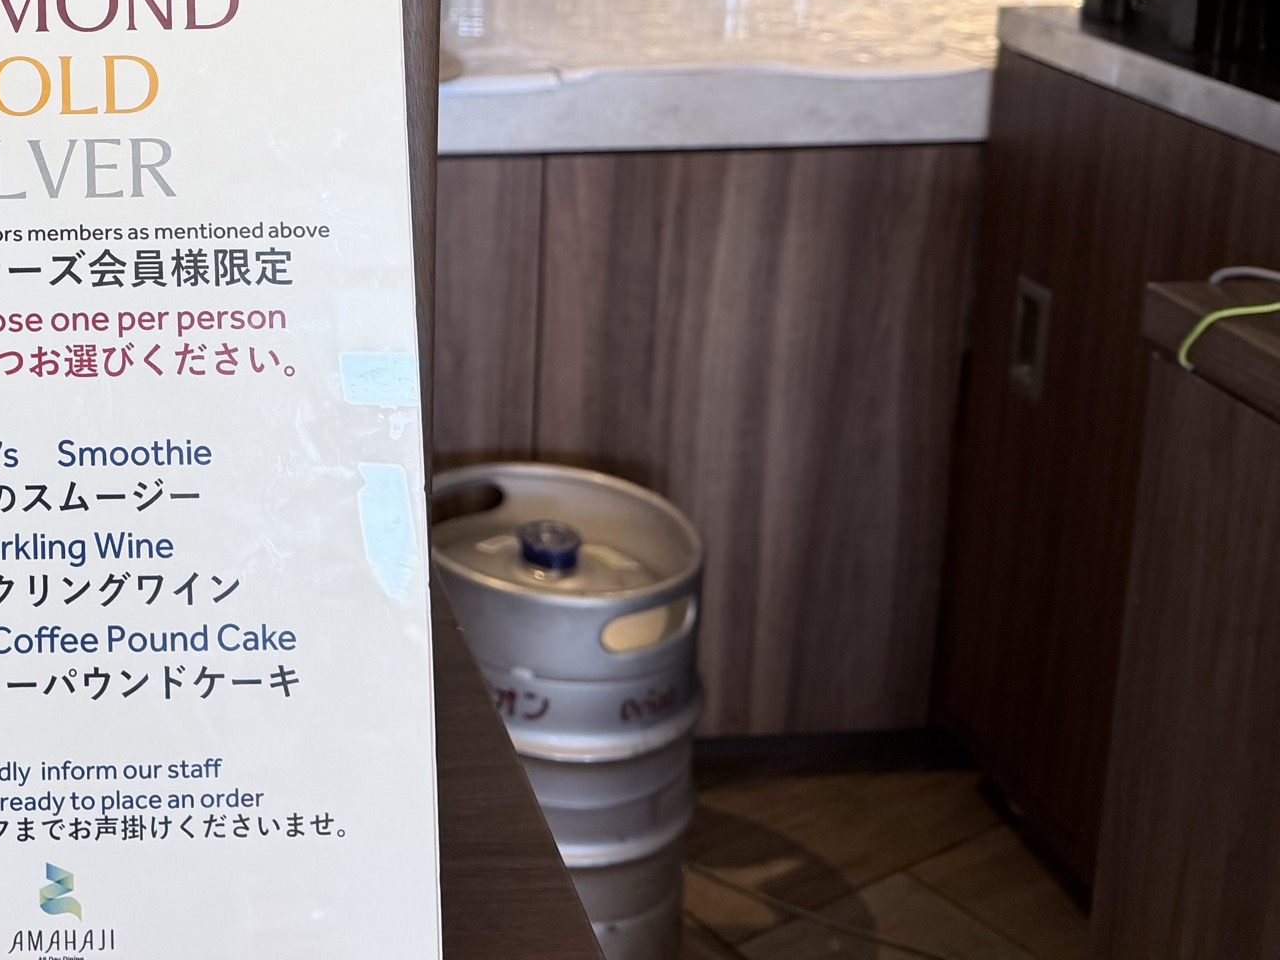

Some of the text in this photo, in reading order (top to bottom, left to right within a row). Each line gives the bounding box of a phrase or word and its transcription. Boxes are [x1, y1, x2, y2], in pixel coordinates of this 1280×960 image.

[27, 223, 124, 242] members
[127, 227, 150, 241] as
[154, 221, 264, 240] mentioned
[268, 221, 330, 239] above
[50, 311, 110, 333] one
[117, 311, 170, 338] per
[176, 309, 287, 338] person
[57, 438, 213, 468] Smoothie
[93, 531, 175, 560] Wine
[107, 623, 209, 653] Pound
[217, 623, 297, 652] Cake
[41, 759, 118, 781] inform
[122, 764, 163, 780] our
[167, 757, 224, 779] staff
[0, 790, 66, 817] ready
[69, 791, 96, 811] to
[101, 789, 163, 817] place
[167, 793, 195, 810] an
[200, 787, 265, 809] order
[7, 928, 115, 954] AMAHAJI
